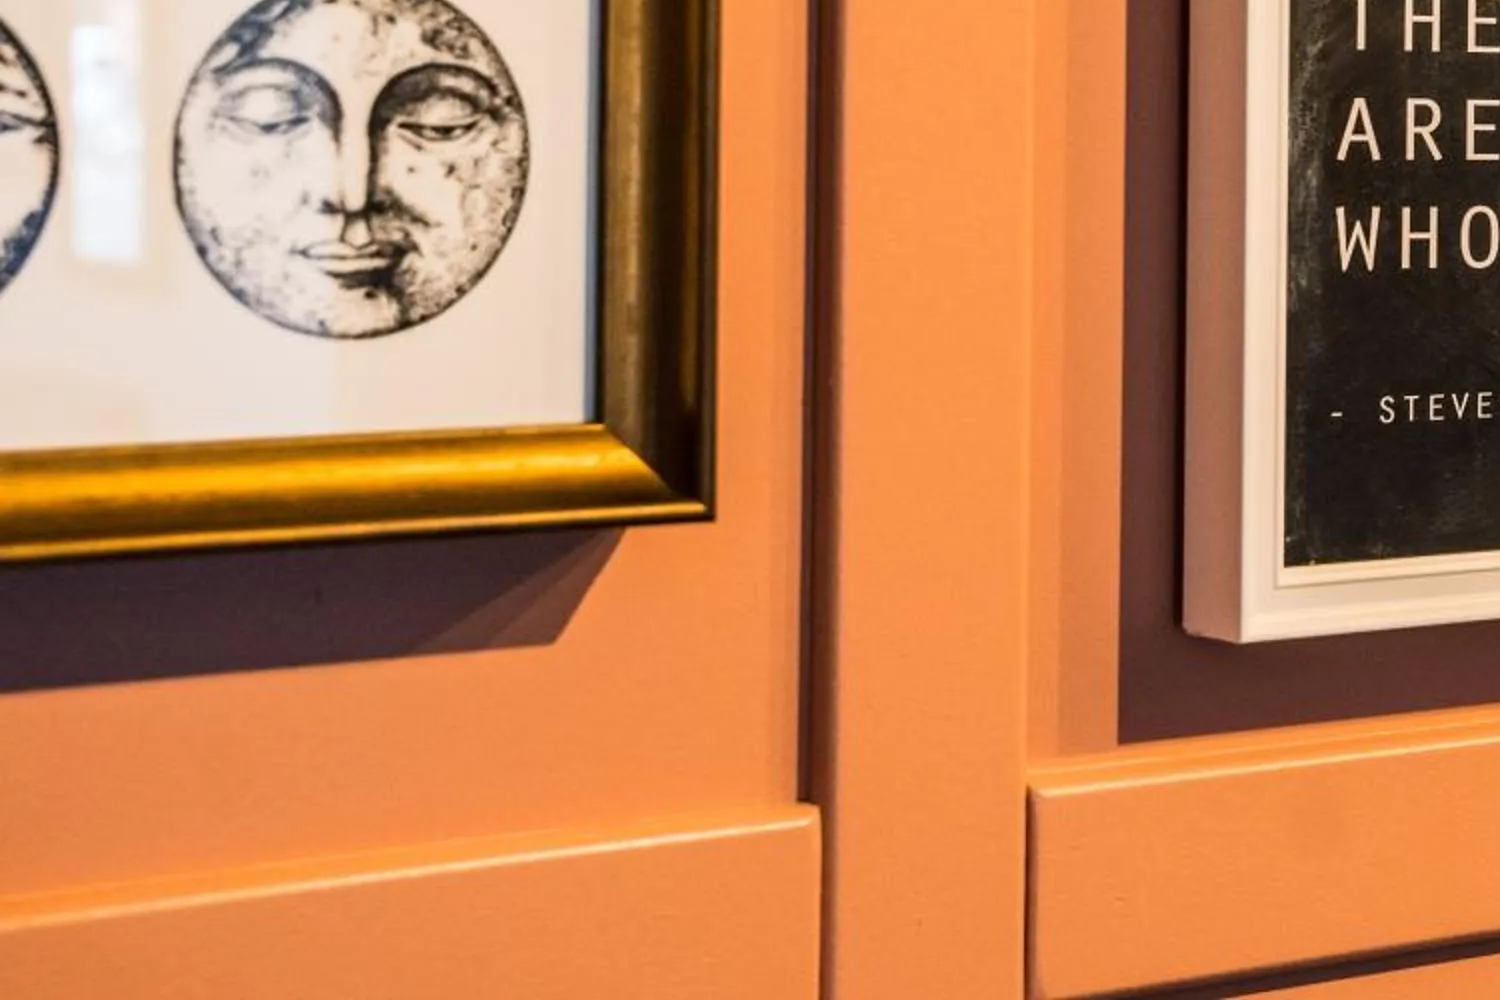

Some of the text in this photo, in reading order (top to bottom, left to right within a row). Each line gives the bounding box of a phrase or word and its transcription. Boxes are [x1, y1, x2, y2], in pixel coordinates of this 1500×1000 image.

[1337, 97, 1500, 161] ARE
[1335, 205, 1500, 272] WHO
[1379, 392, 1493, 424] STEVE
